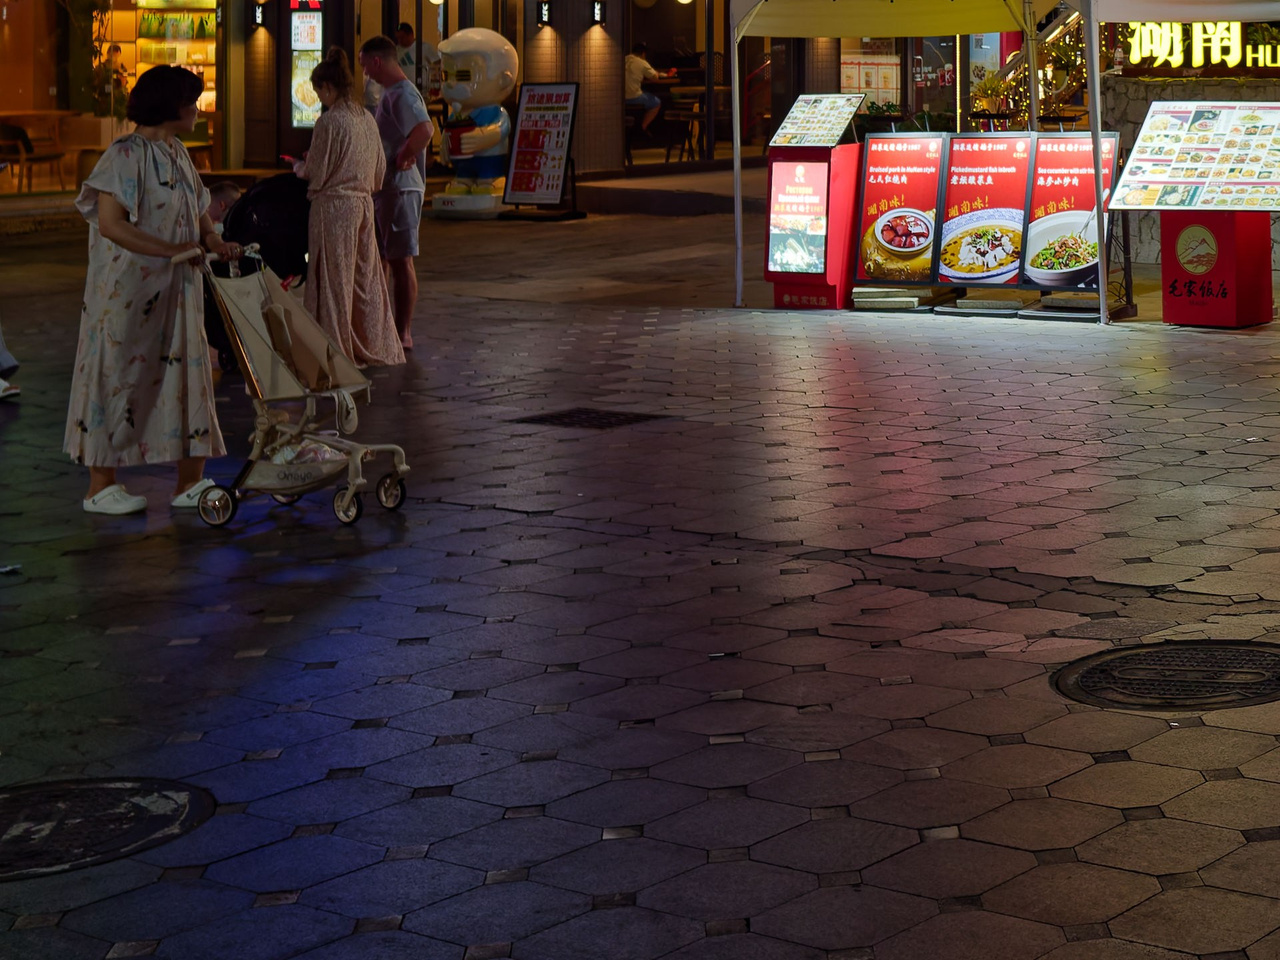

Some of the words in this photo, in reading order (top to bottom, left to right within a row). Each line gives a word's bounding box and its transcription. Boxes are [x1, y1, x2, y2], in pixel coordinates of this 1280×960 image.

[255, 5, 263, 24] KFC
[542, 2, 550, 22] KFC
[594, 1, 602, 22] KFC
[1127, 21, 1242, 68] 湖南
